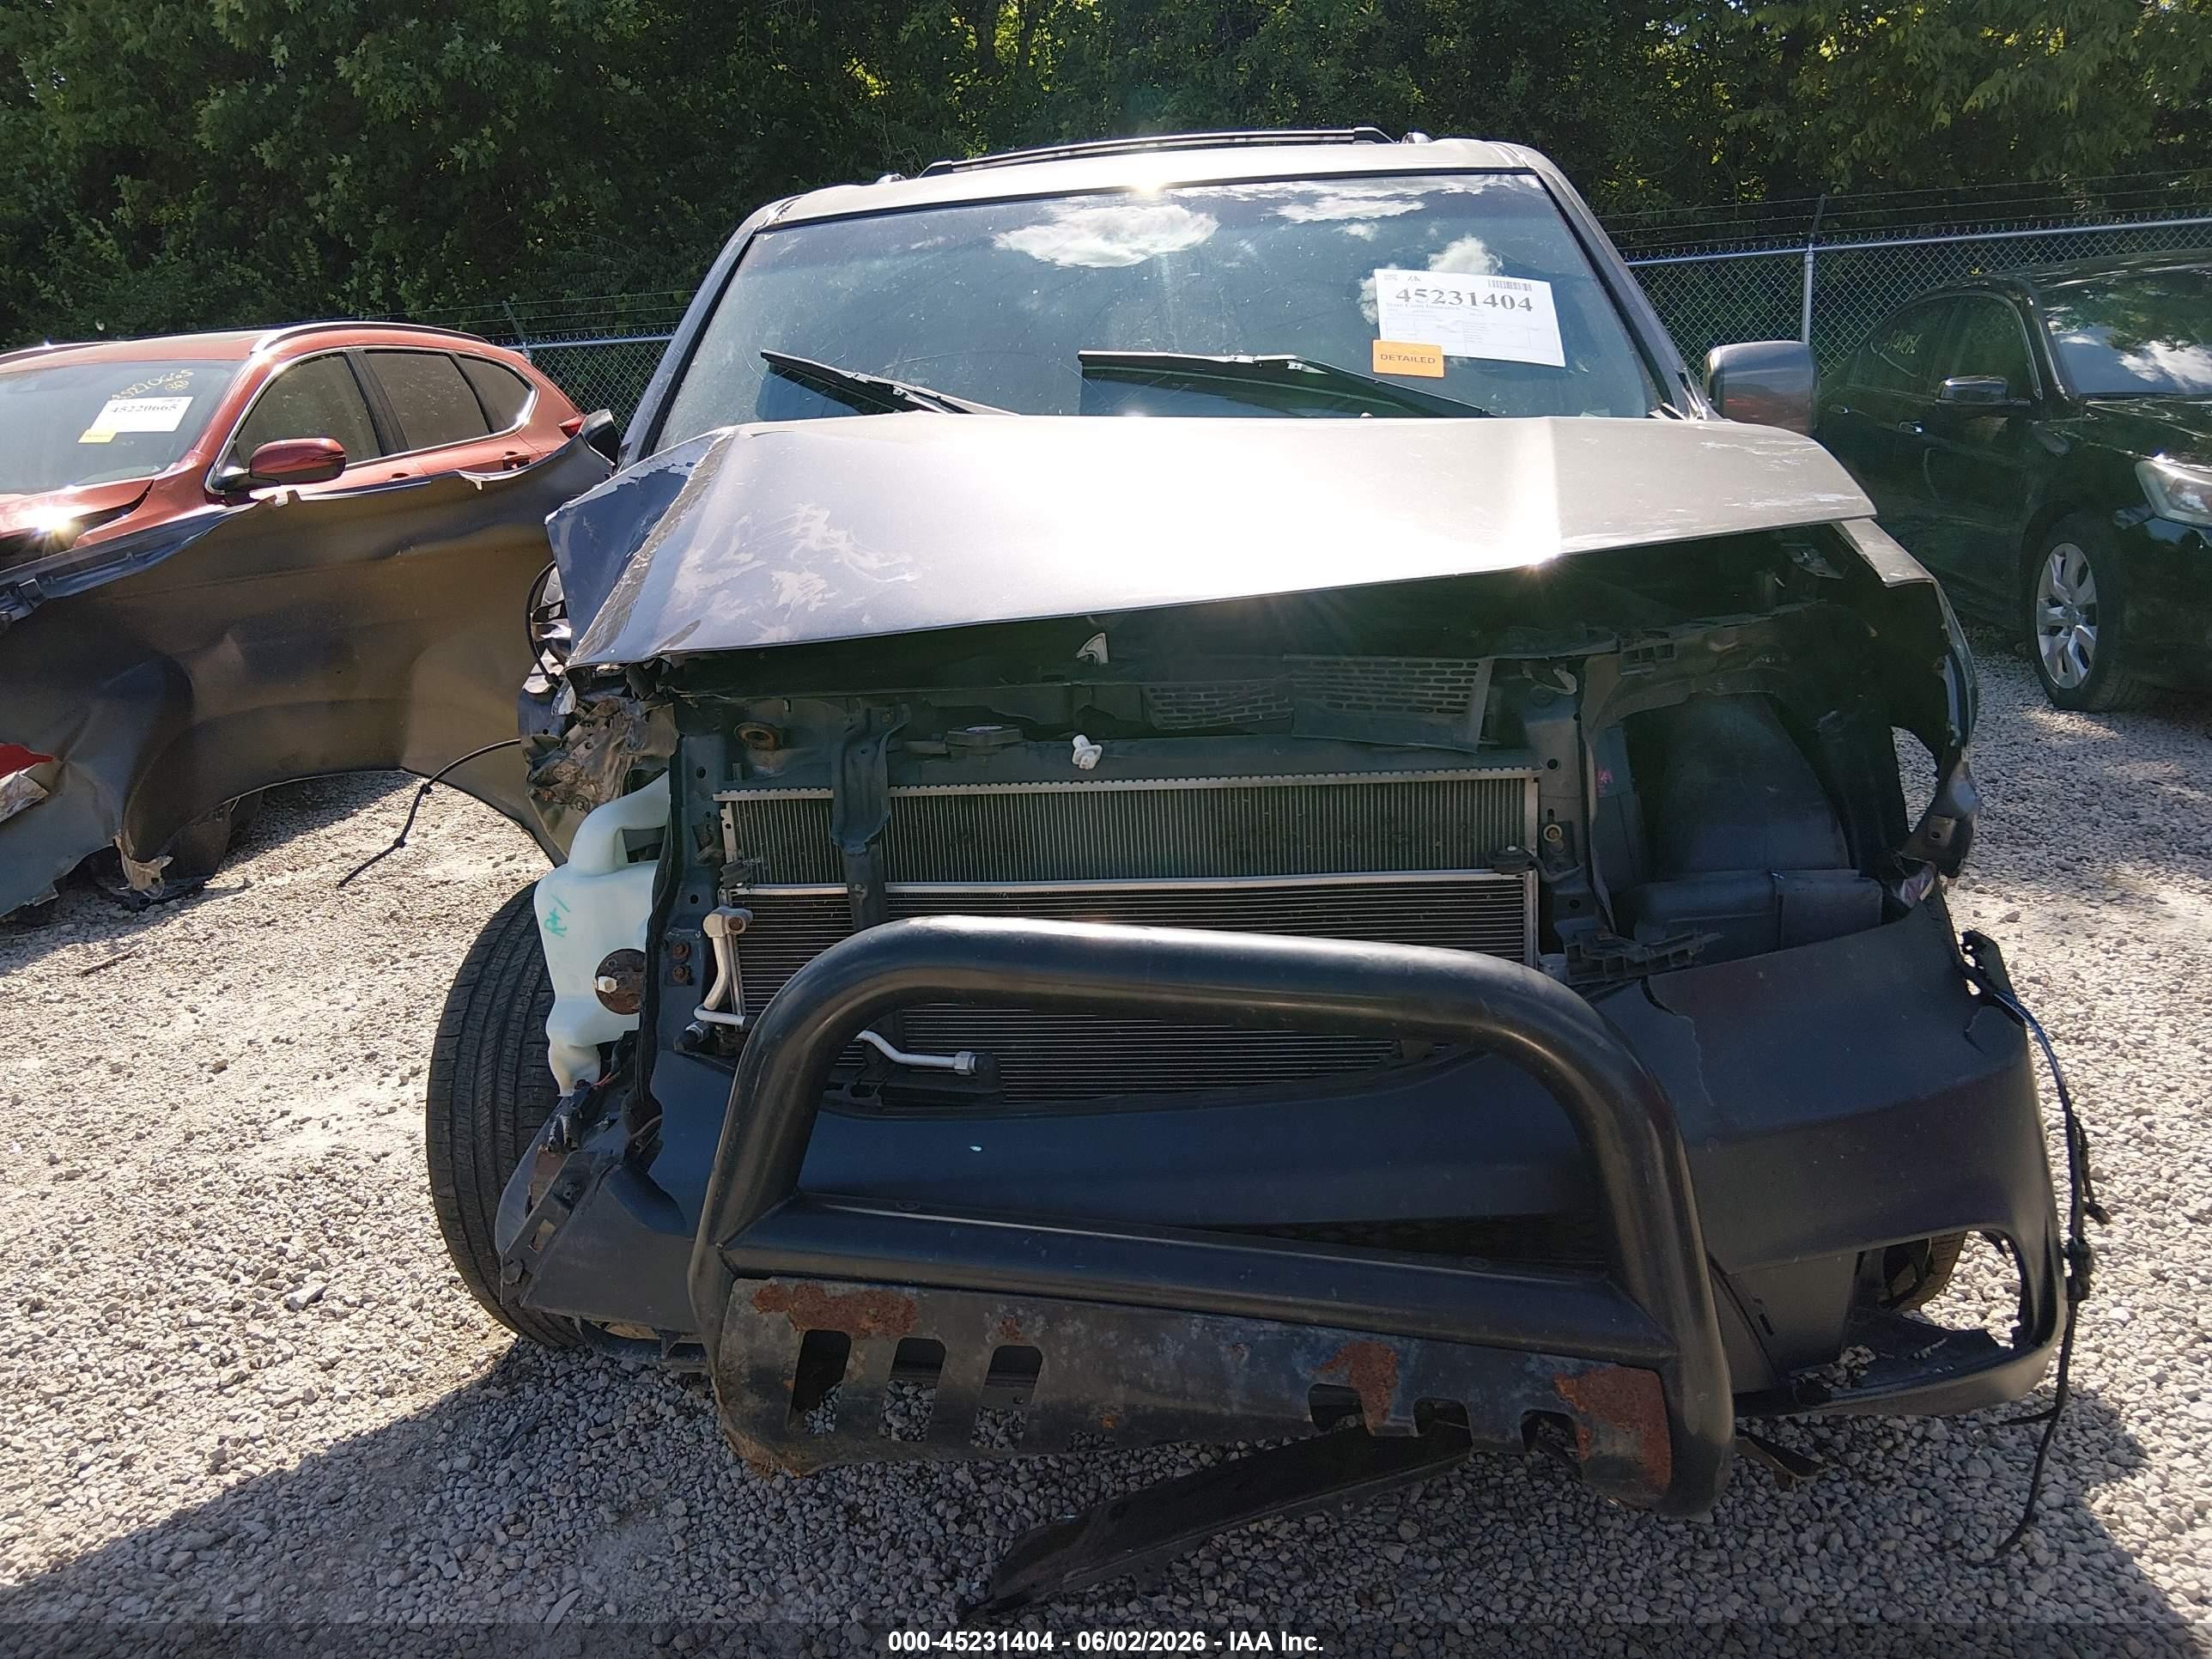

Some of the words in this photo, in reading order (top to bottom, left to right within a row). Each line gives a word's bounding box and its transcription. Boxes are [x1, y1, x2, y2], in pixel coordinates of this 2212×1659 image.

[1395, 289, 1533, 312] 45231404
[1380, 353, 1436, 365] DETAILED
[110, 404, 177, 412] 45220665
